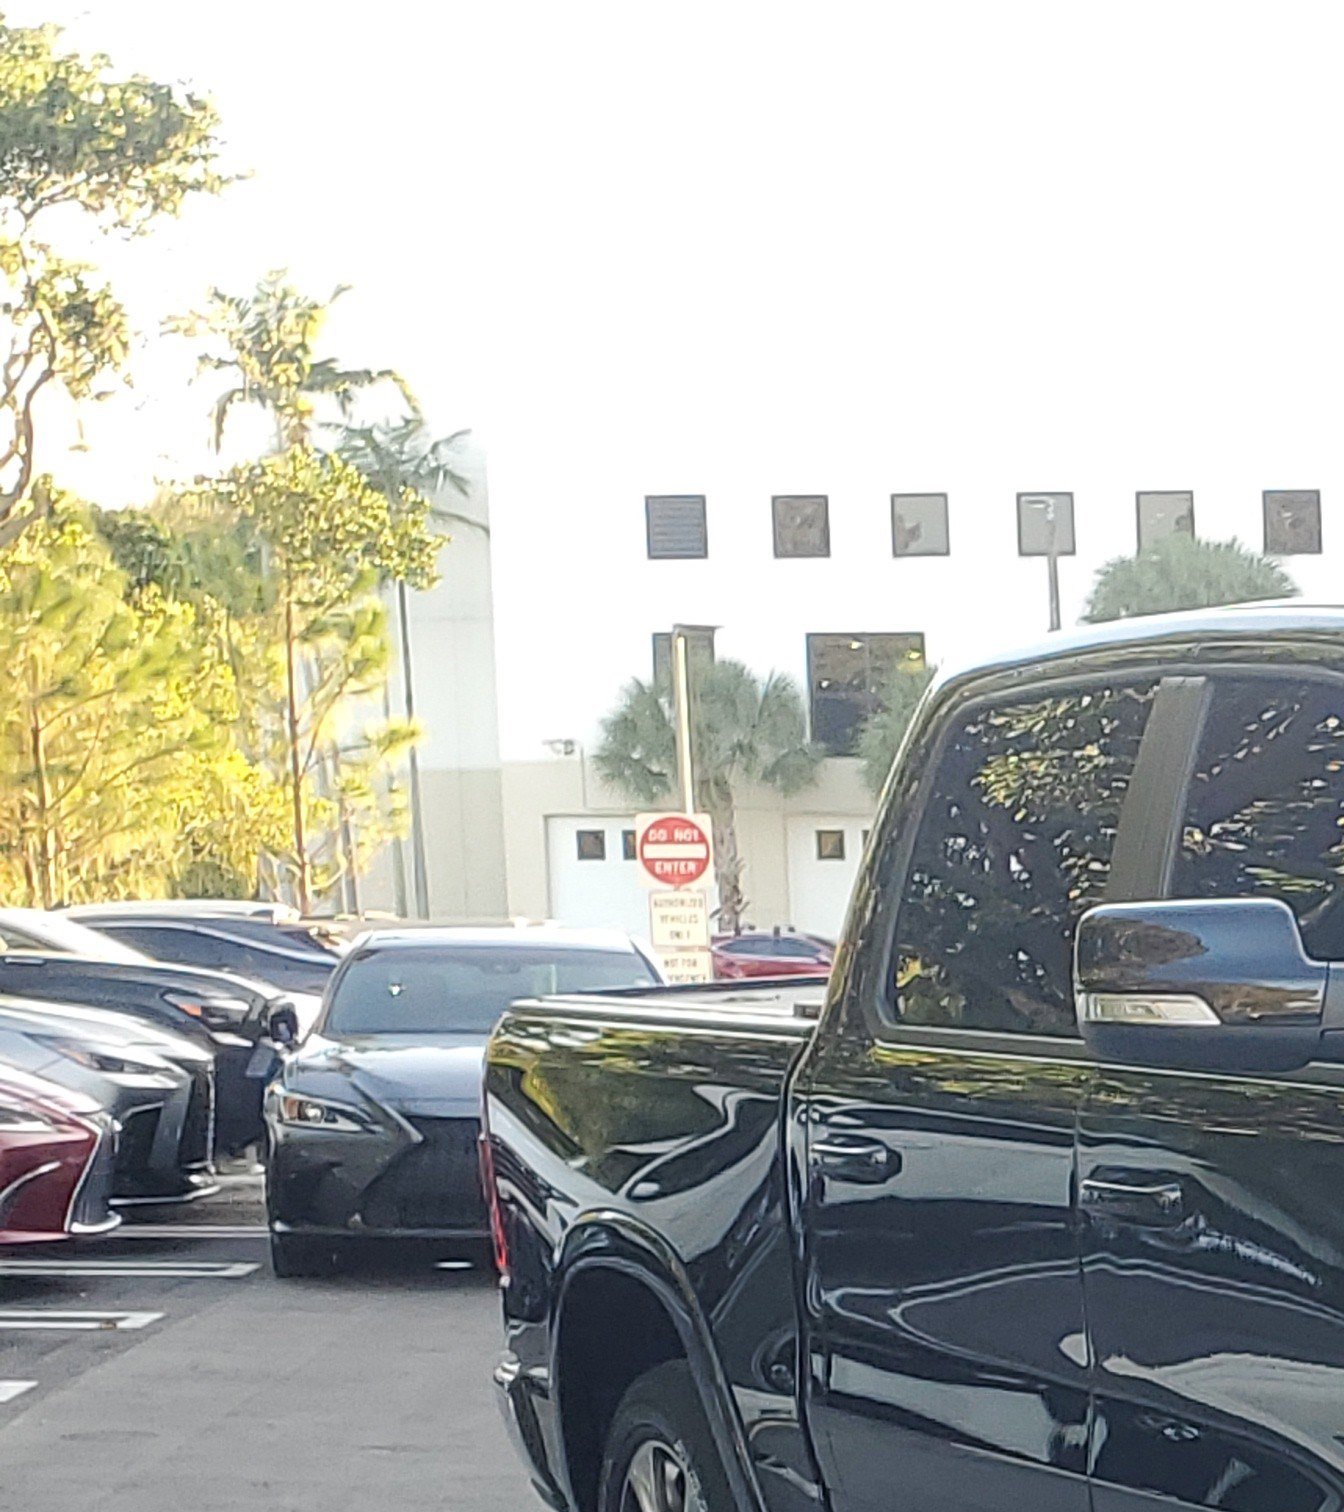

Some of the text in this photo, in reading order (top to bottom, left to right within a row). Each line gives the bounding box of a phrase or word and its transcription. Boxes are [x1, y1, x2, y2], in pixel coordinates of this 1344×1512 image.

[648, 828, 699, 841] DO NOT
[654, 861, 697, 875] ENTER
